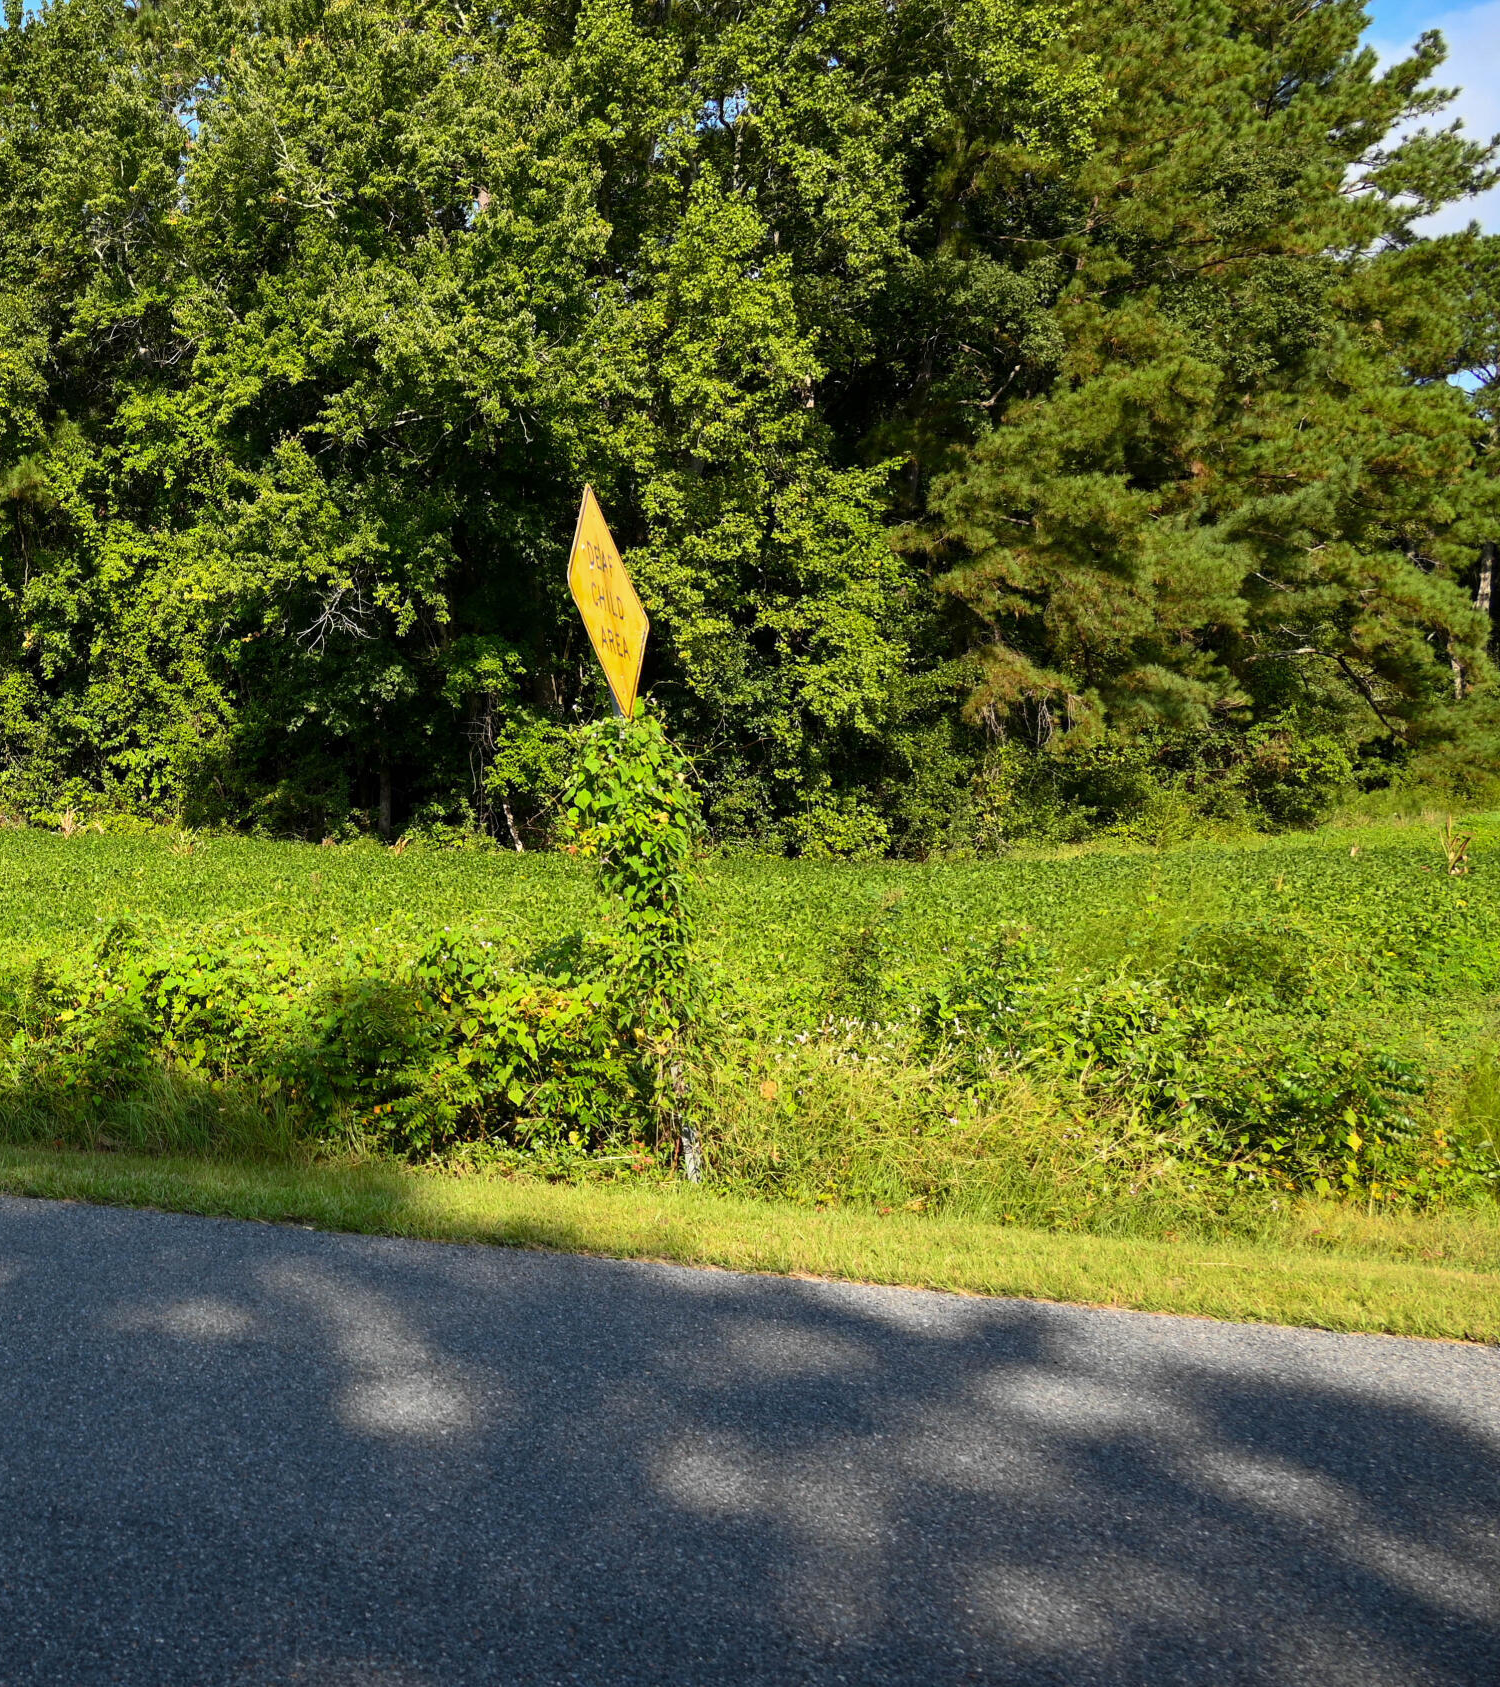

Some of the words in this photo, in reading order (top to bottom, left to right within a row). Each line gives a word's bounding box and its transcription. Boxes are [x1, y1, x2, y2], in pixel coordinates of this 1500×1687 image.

[586, 541, 613, 578] DEAF
[591, 581, 625, 620] CHILD
[601, 625, 631, 661] AREA
